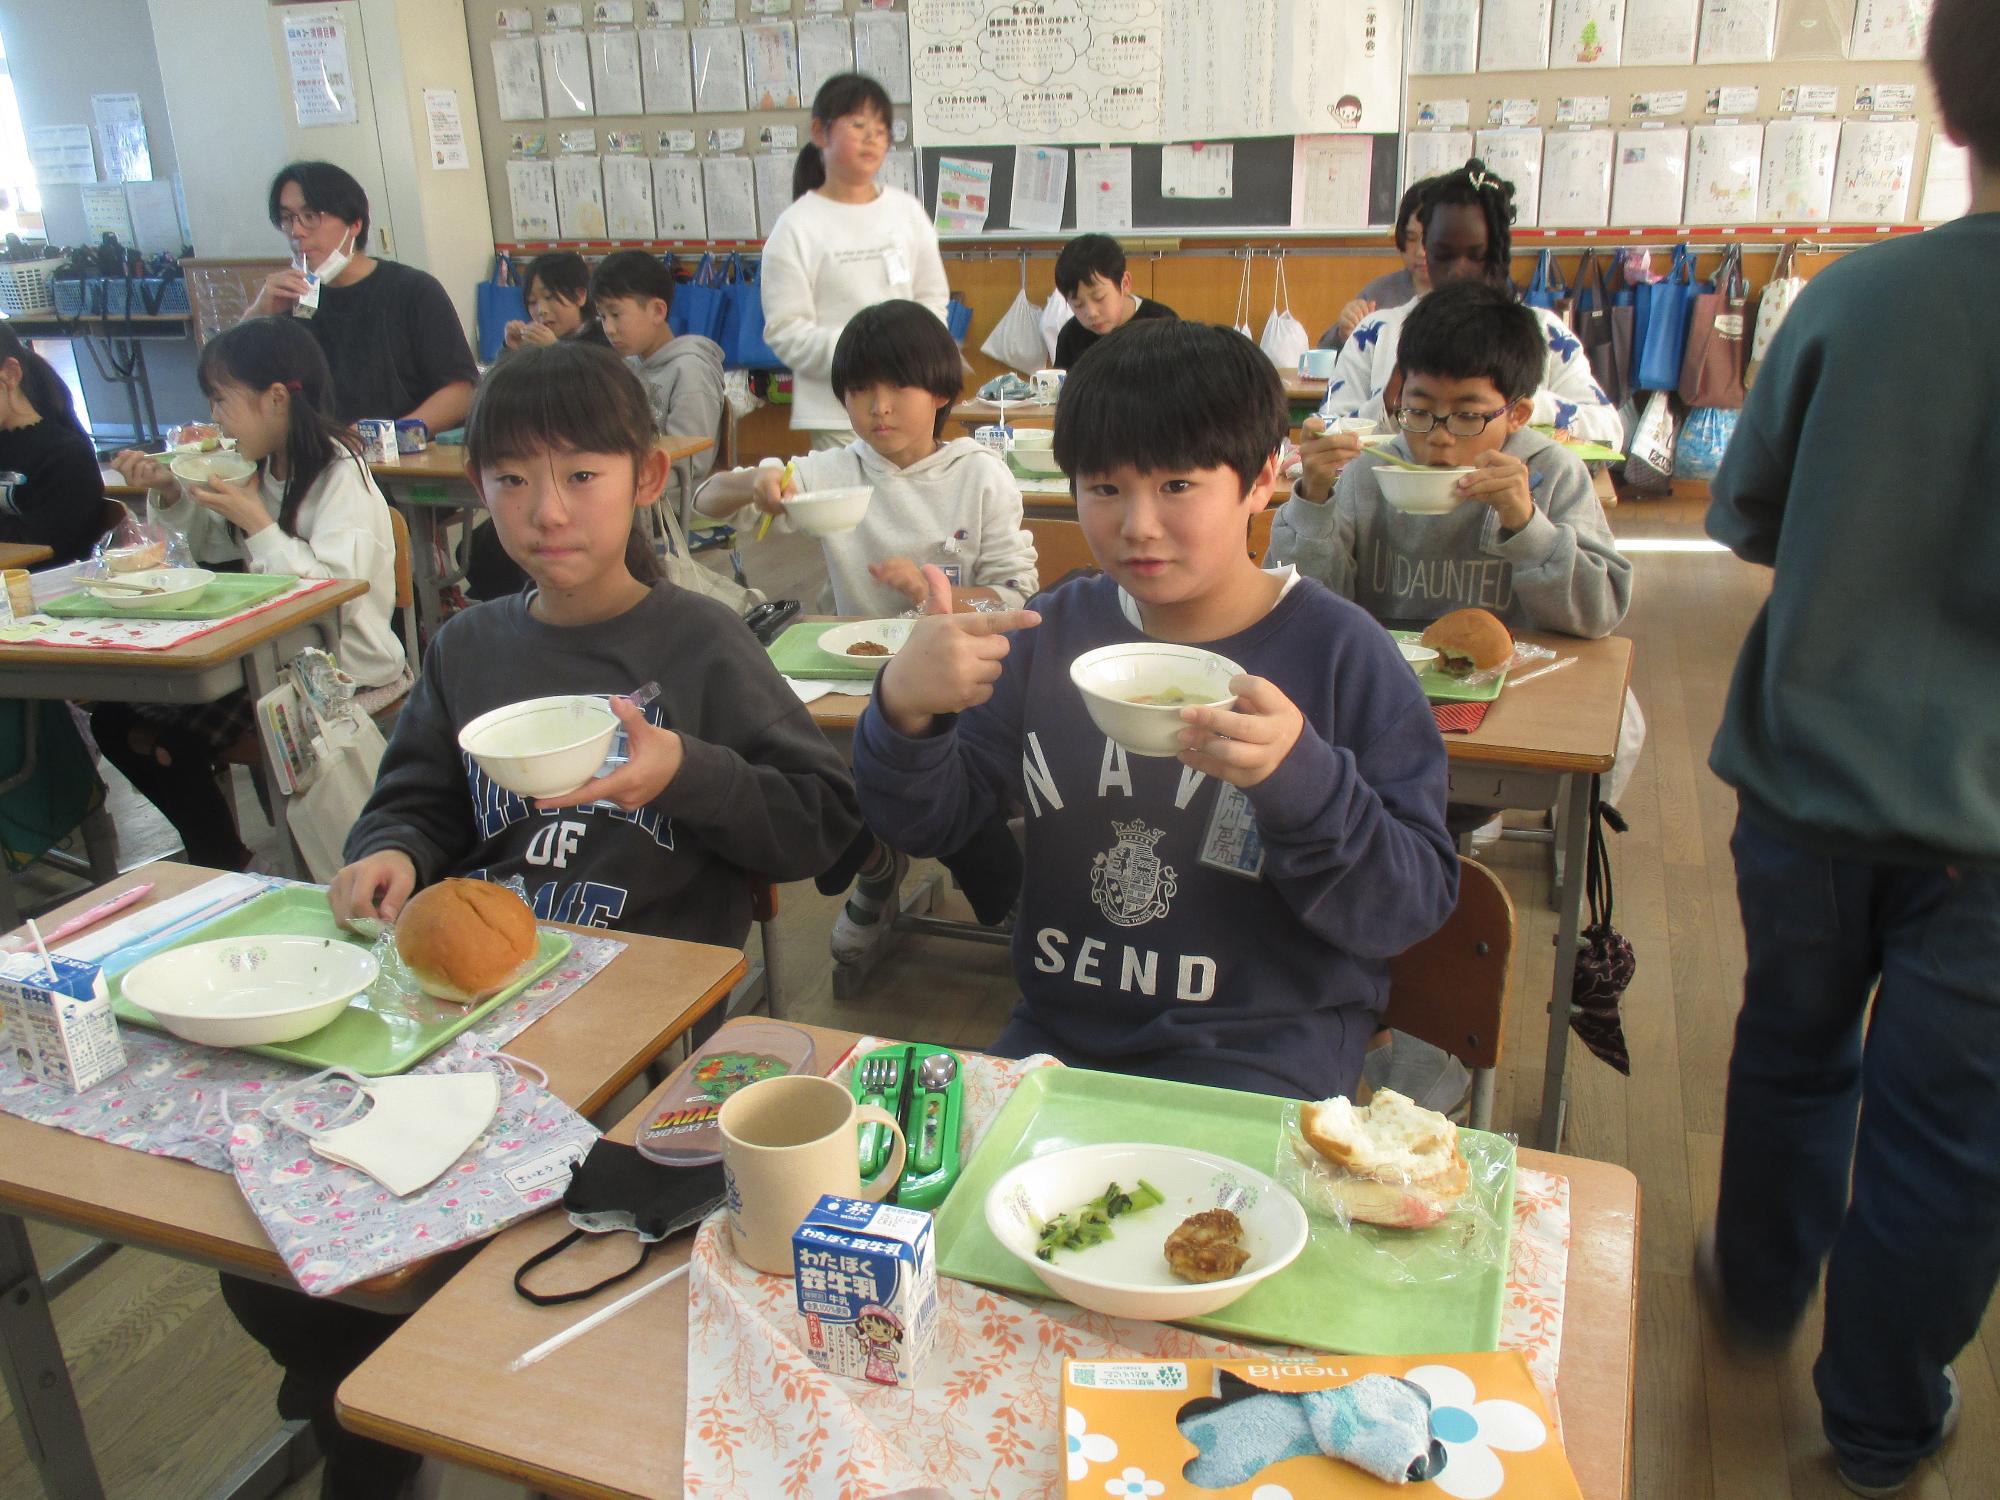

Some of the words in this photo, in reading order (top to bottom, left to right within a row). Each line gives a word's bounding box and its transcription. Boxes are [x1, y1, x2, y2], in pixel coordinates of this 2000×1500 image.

[1372, 539, 1514, 612] UNDAUNTED
[525, 820, 587, 869] OF
[1034, 927, 1218, 1002] SEND
[801, 1228, 850, 1246] わたぼく
[800, 1247, 875, 1278] わたぼく
[828, 1294, 850, 1306] 牛乳
[1248, 1364, 1349, 1379] nepia
